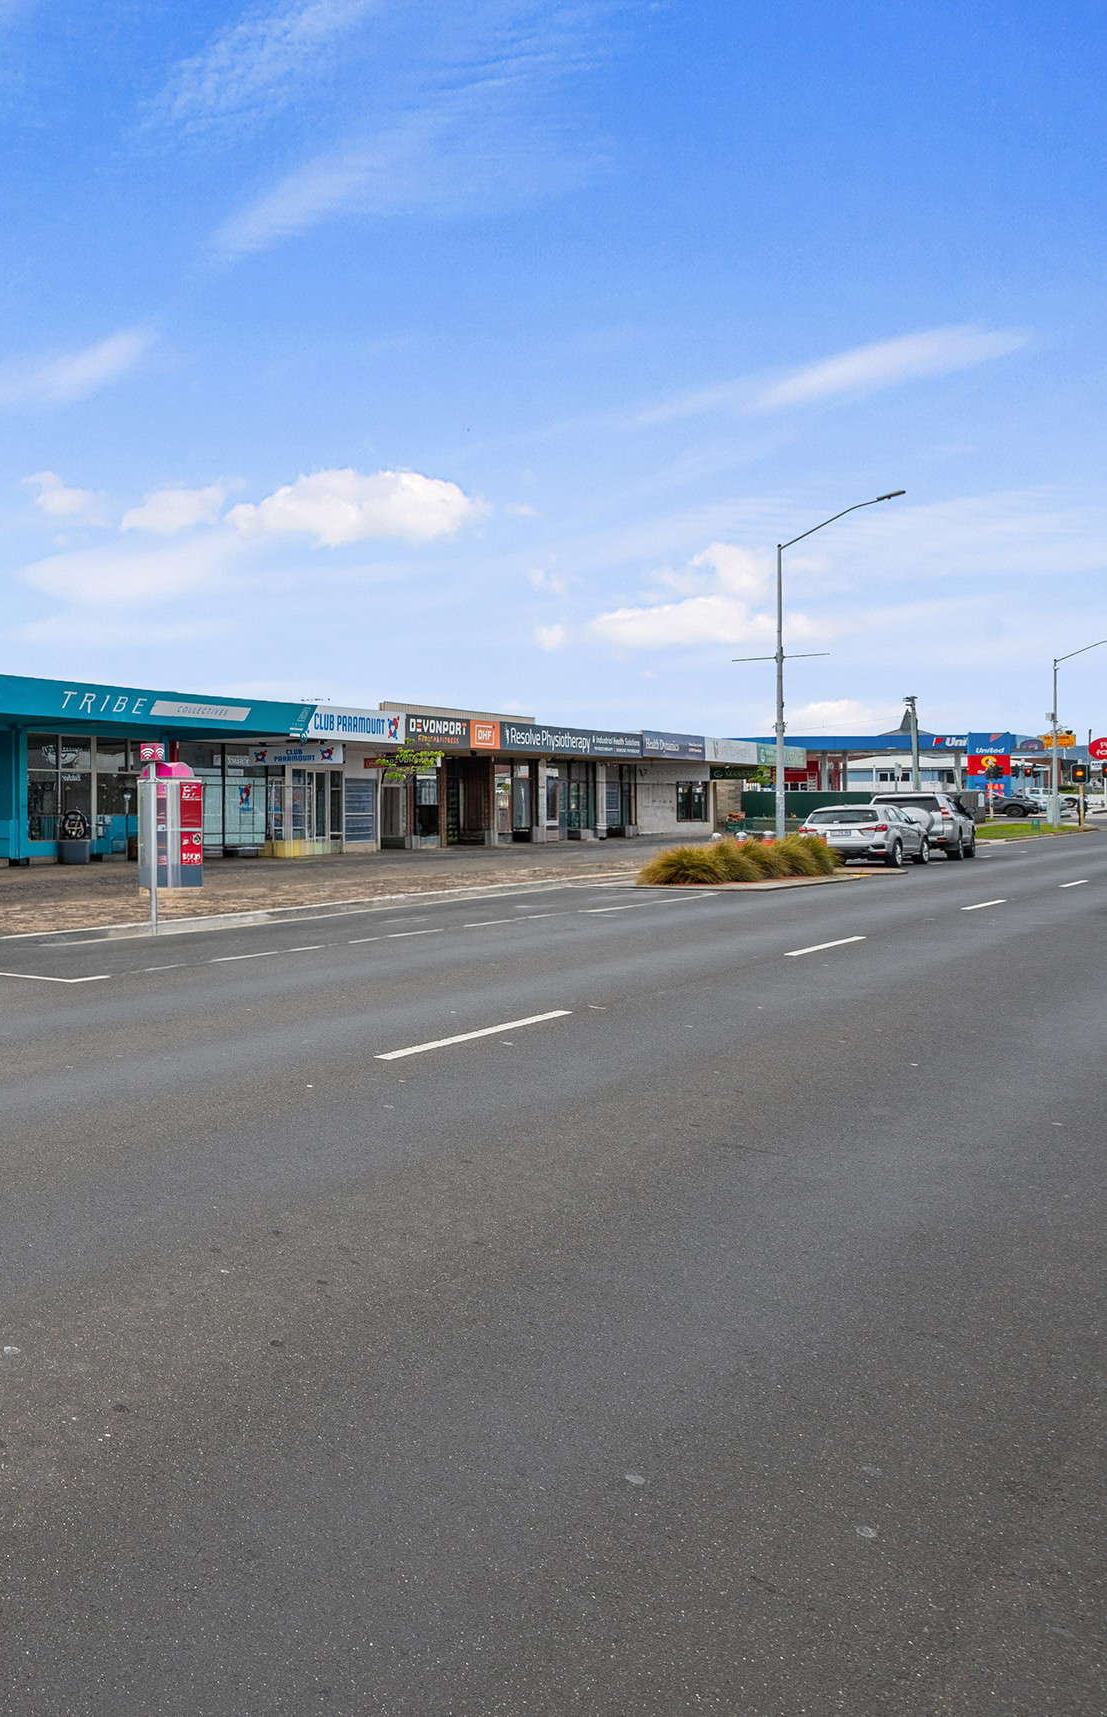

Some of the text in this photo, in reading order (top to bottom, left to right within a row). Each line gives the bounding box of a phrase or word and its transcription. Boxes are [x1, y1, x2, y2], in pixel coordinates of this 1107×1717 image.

[61, 690, 148, 715] TRIBE
[176, 705, 229, 717] COLLECTIVES
[314, 712, 386, 735] CLUB PARAMOUNT
[409, 718, 468, 736] DEVONPORT
[478, 729, 492, 741] DHF
[510, 727, 591, 753] Resolve Physiotherapy
[625, 738, 641, 747] Solutions
[945, 737, 968, 747] Uni
[645, 738, 680, 753] Health Dynamics
